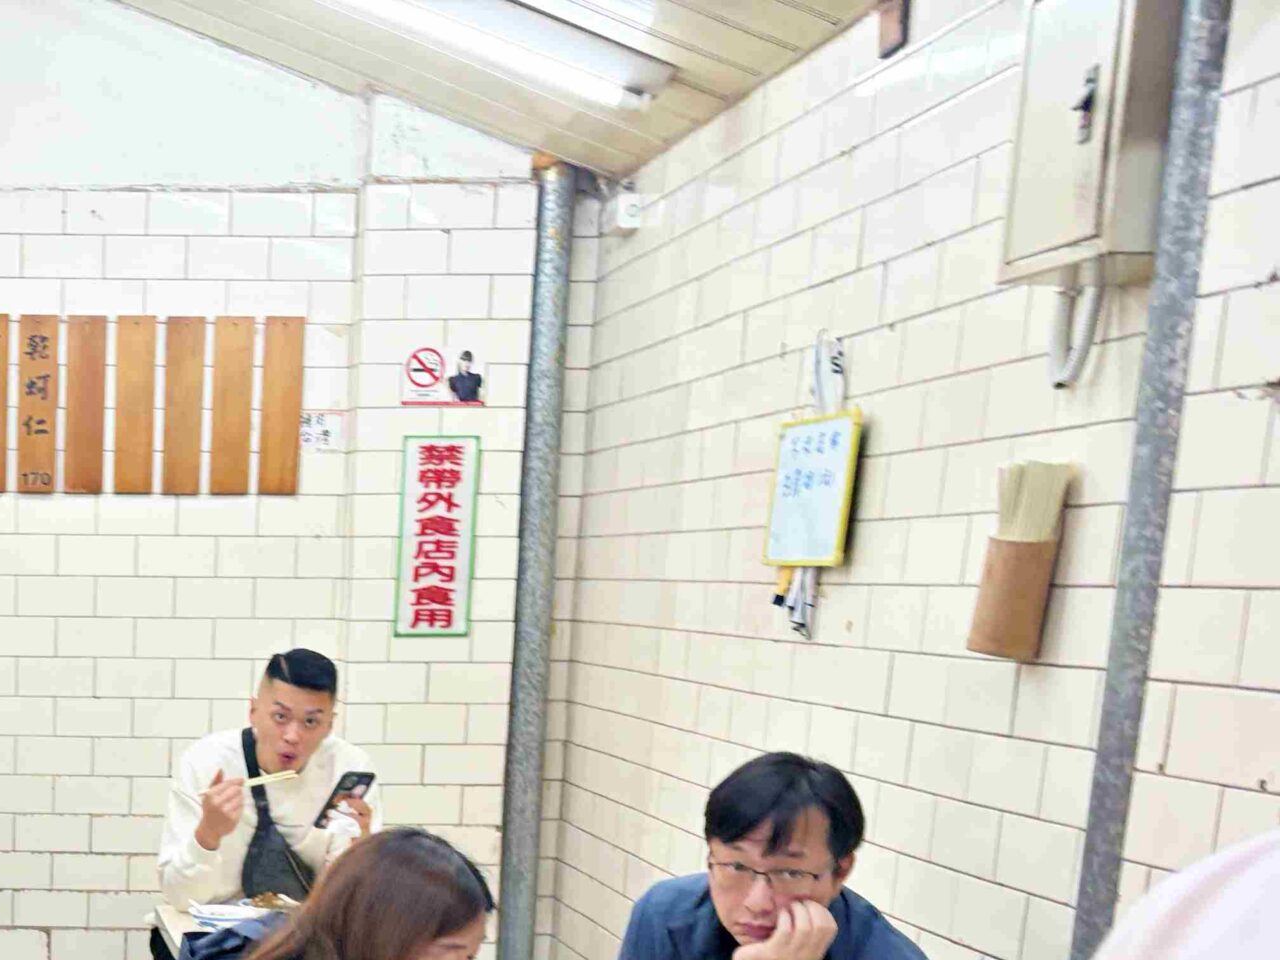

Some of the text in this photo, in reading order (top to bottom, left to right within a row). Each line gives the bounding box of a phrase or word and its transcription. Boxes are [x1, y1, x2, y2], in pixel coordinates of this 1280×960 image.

[21, 471, 53, 487] 170
[409, 444, 466, 630] 禁帶外食店內食用
